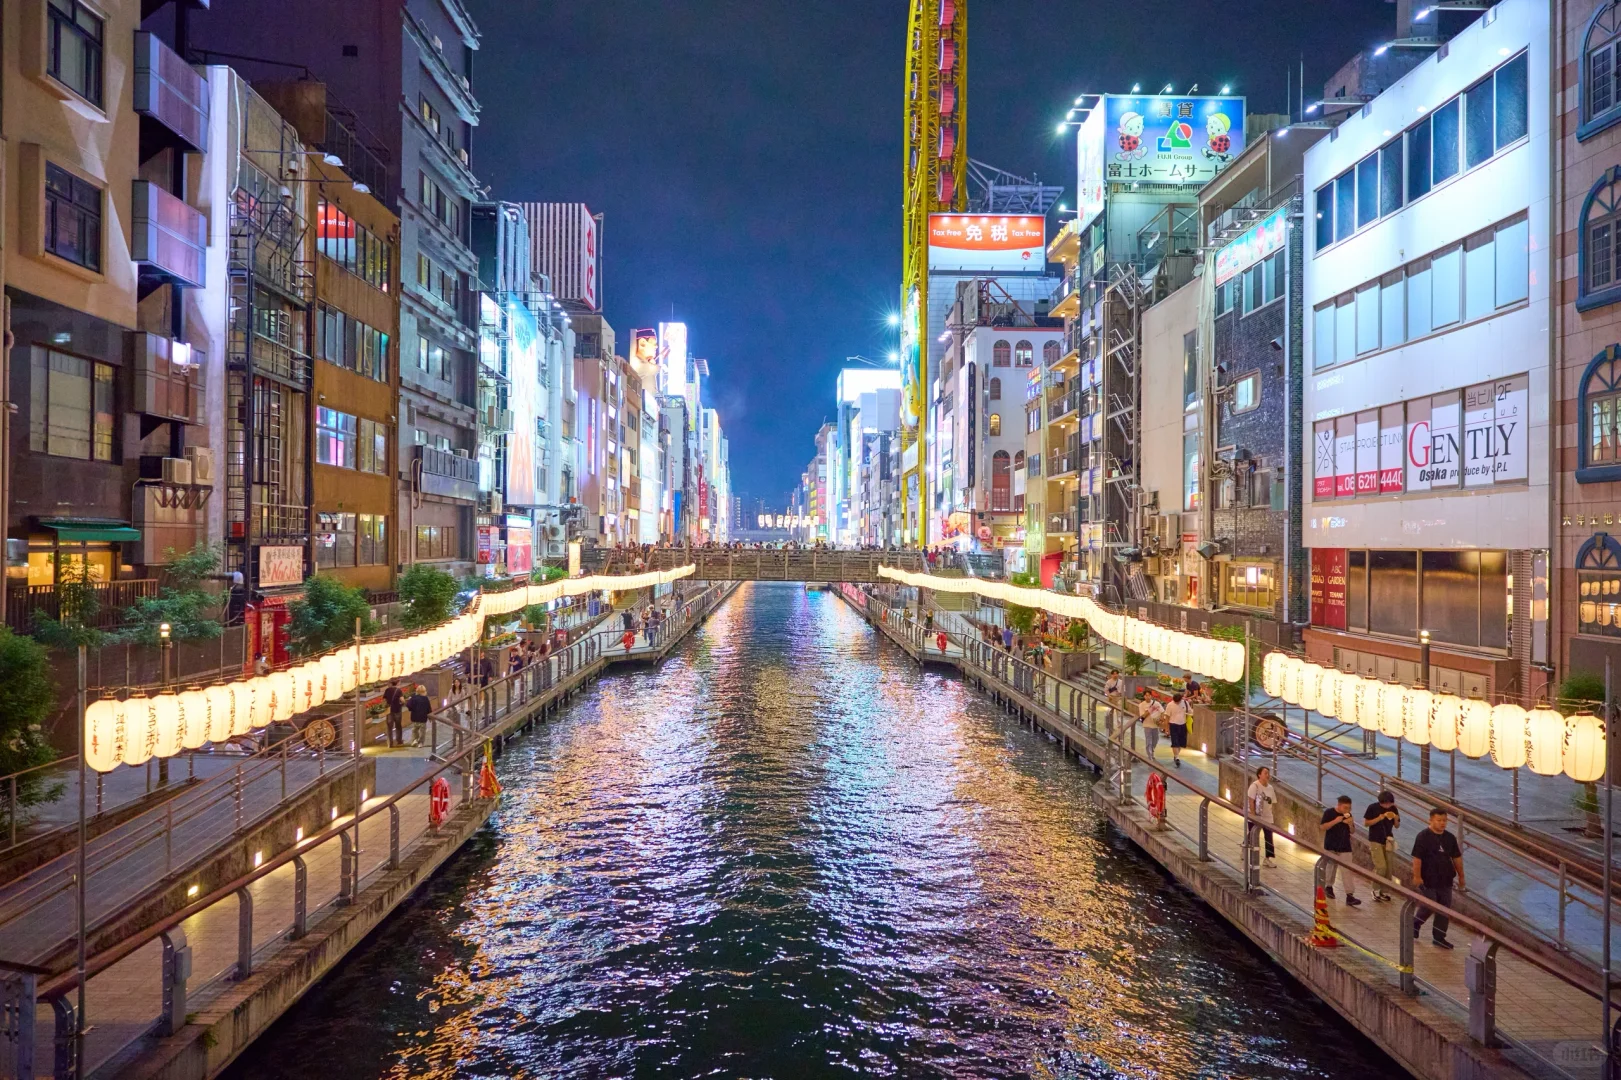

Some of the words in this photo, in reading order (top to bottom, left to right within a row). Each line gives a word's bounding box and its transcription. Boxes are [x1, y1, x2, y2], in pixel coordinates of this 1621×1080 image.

[965, 224, 1008, 242] 免税
[1011, 229, 1024, 237] Tax
[1026, 229, 1041, 237] Free
[586, 221, 595, 300] かに
[1497, 382, 1512, 402] 2F
[1408, 421, 1518, 468] GENTLY
[1344, 476, 1355, 491] 06
[1358, 472, 1377, 490] 6211
[1380, 468, 1402, 487] 4440
[1419, 467, 1447, 482] Osaka
[1481, 464, 1491, 476] by
[1331, 565, 1342, 574] ABC
[1327, 575, 1346, 586] GARDEN
[1328, 598, 1345, 607] BUILDING
